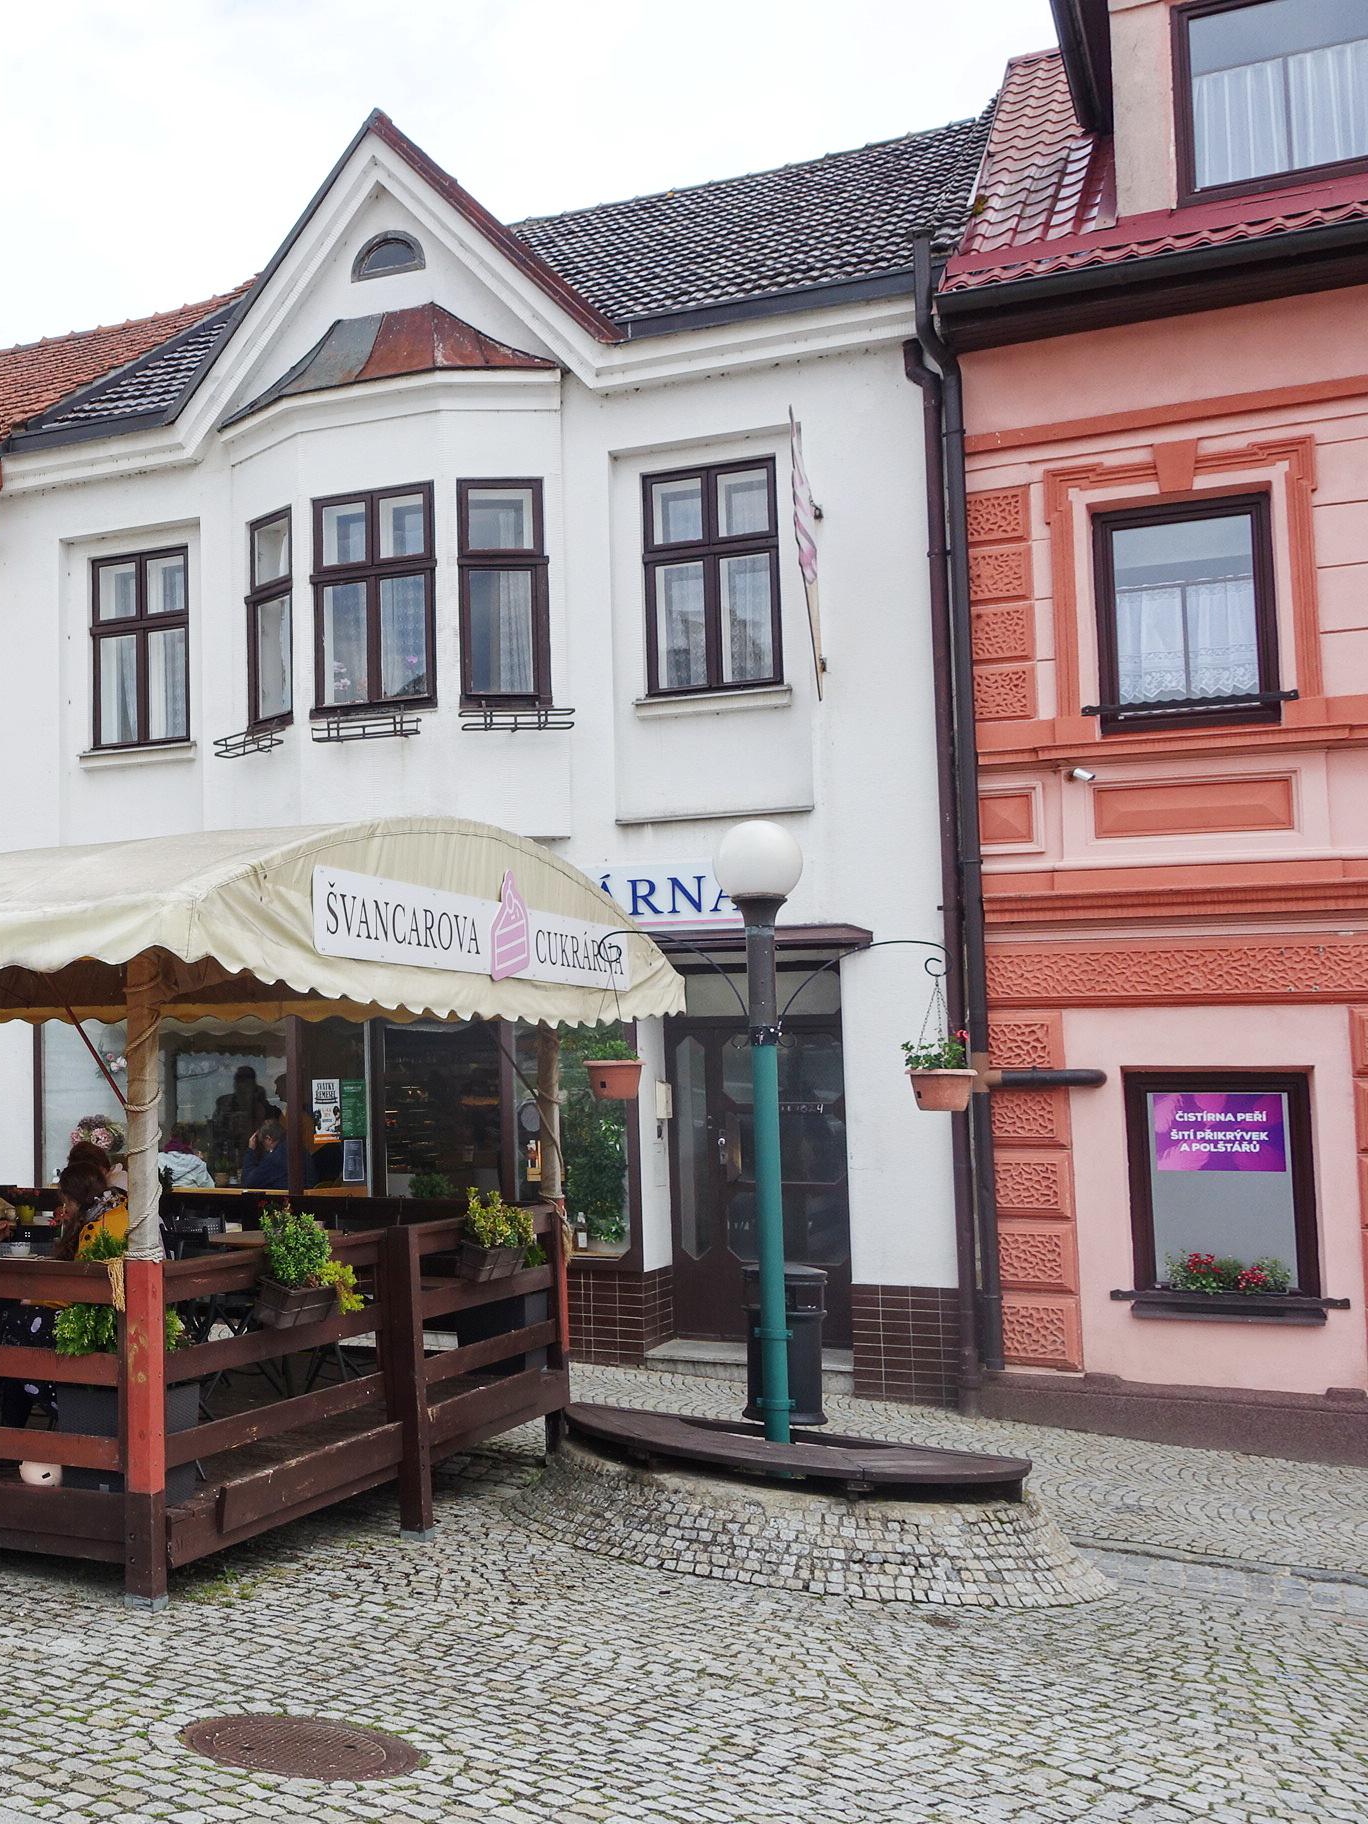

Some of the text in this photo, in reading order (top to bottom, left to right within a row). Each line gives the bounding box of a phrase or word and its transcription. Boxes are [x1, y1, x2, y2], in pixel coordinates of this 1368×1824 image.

[326, 880, 625, 975] ŠVANCAROVA CUKRÁRNA
[1175, 1110, 1267, 1122] ČISTÍRNA PEŘÍ
[1170, 1128, 1269, 1141] ŠITÍ PŘIKRÝVEK
[1179, 1140, 1260, 1153] A POLŠTÁŘŮ
